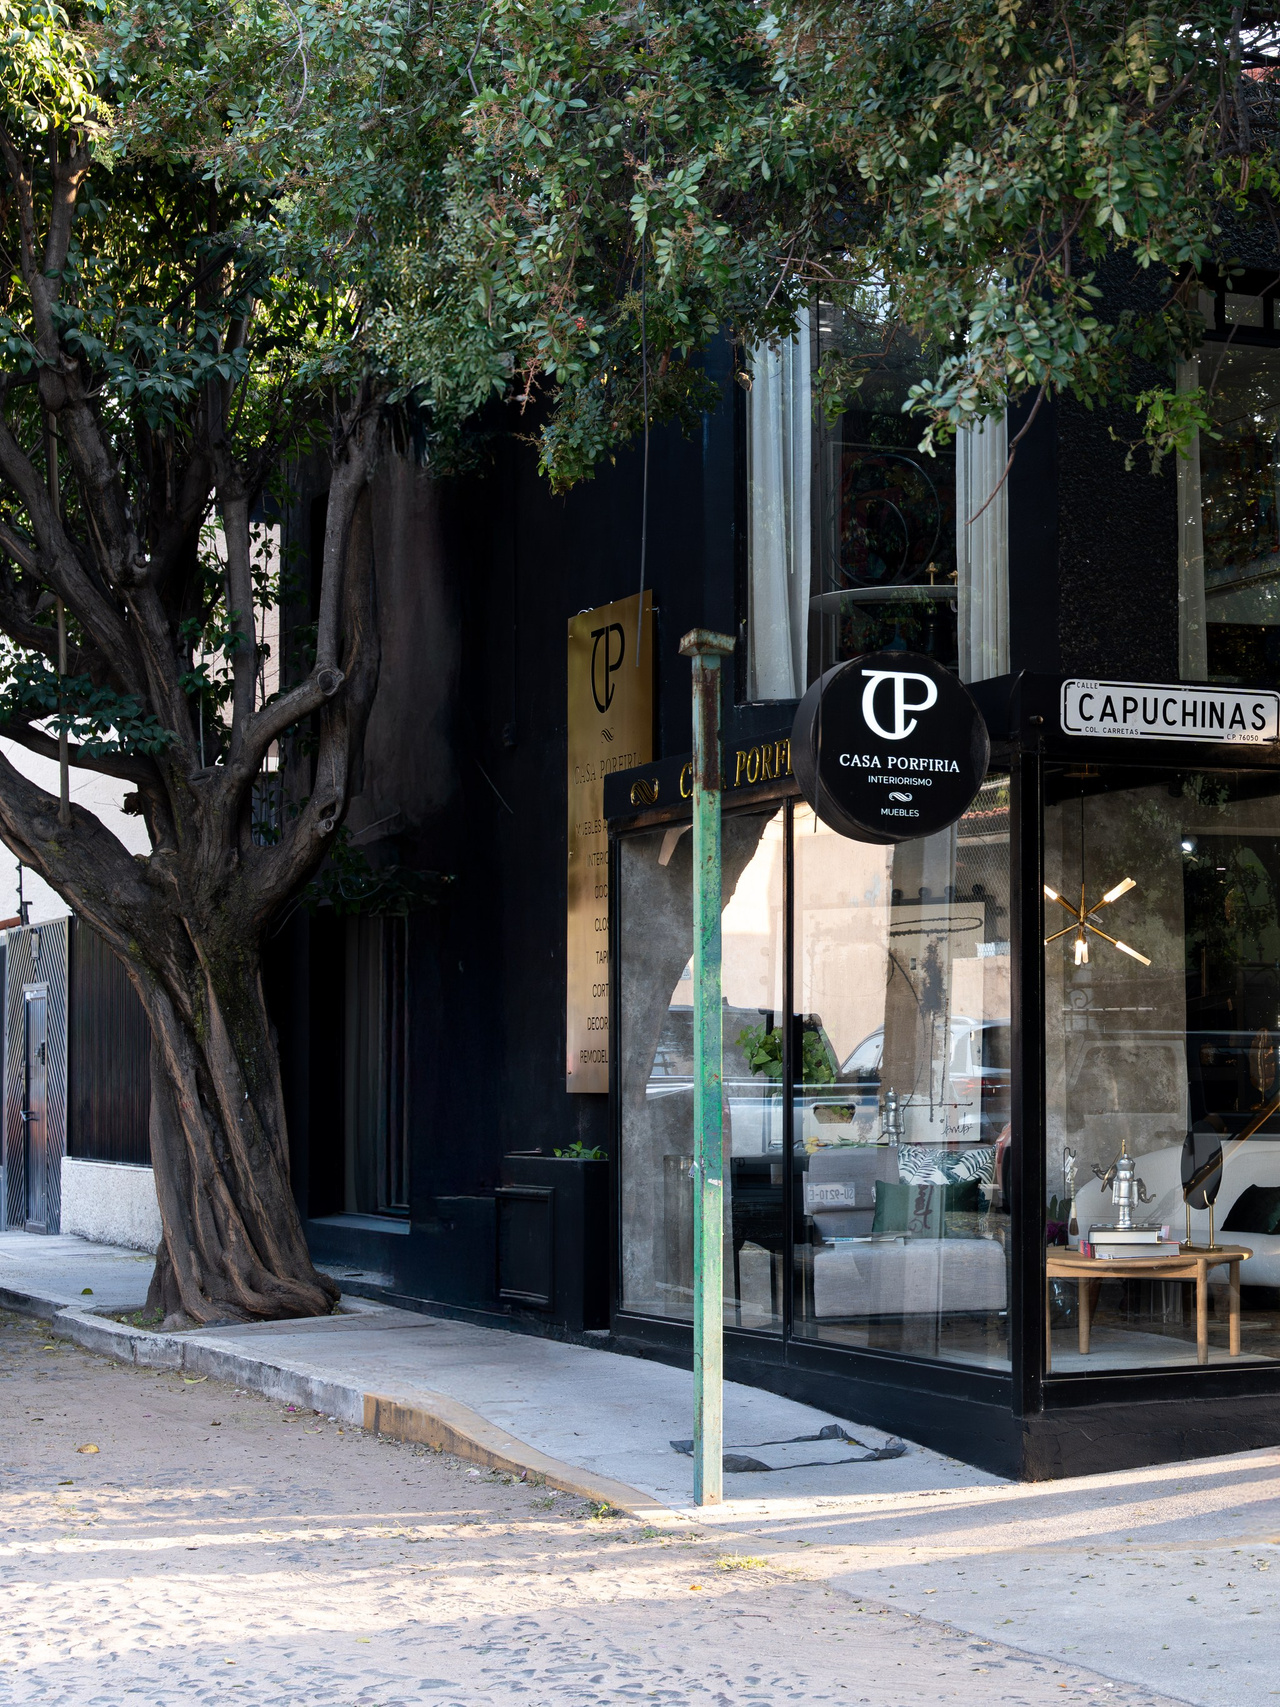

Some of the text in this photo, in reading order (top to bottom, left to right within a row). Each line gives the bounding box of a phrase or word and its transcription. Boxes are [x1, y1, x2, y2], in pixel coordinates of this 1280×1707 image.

[1076, 681, 1098, 690] CALLE
[1079, 692, 1266, 731] CAPUCHINAS
[1102, 727, 1139, 736] CARRETAS
[1239, 734, 1259, 742] 76050
[839, 753, 961, 773] CASA PORFIRIA
[574, 763, 597, 785] CASA
[868, 775, 933, 787] INTERIORISMO
[880, 808, 920, 817] MUEBLES
